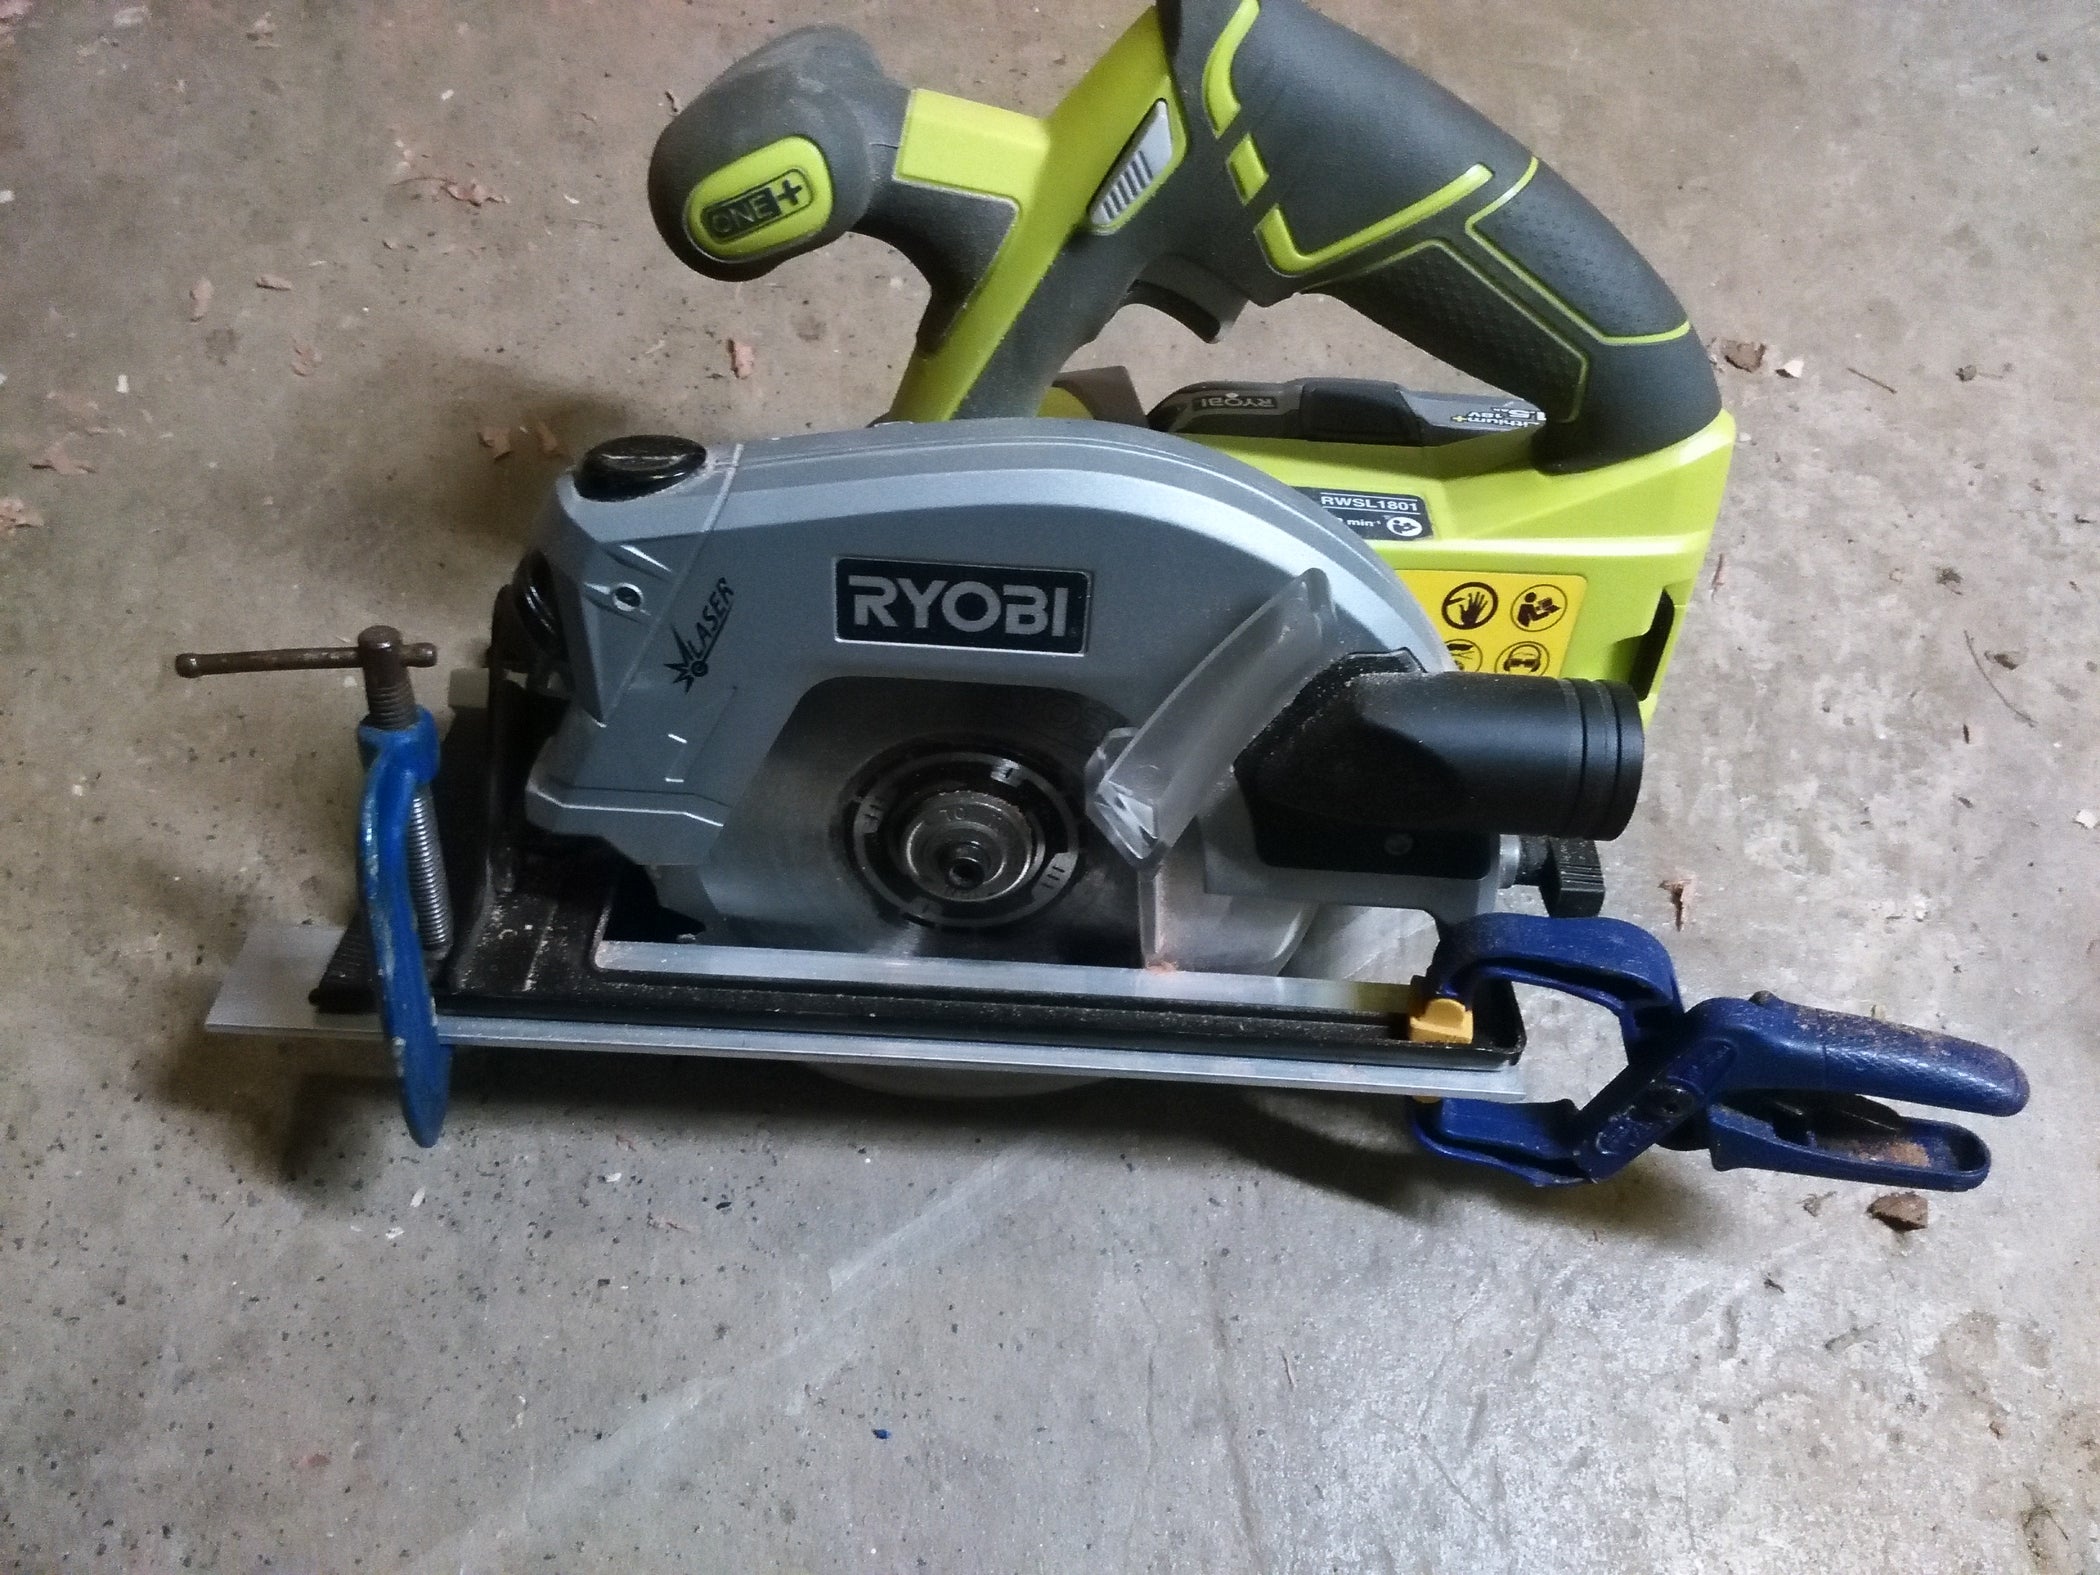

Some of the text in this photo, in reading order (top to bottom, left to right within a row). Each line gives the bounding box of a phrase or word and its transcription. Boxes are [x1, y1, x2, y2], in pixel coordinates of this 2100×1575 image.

[1201, 396, 1276, 408] RYOBI
[1321, 496, 1418, 511] RWSL1801
[687, 577, 734, 660] LASER
[849, 575, 1068, 637] RYOBI
